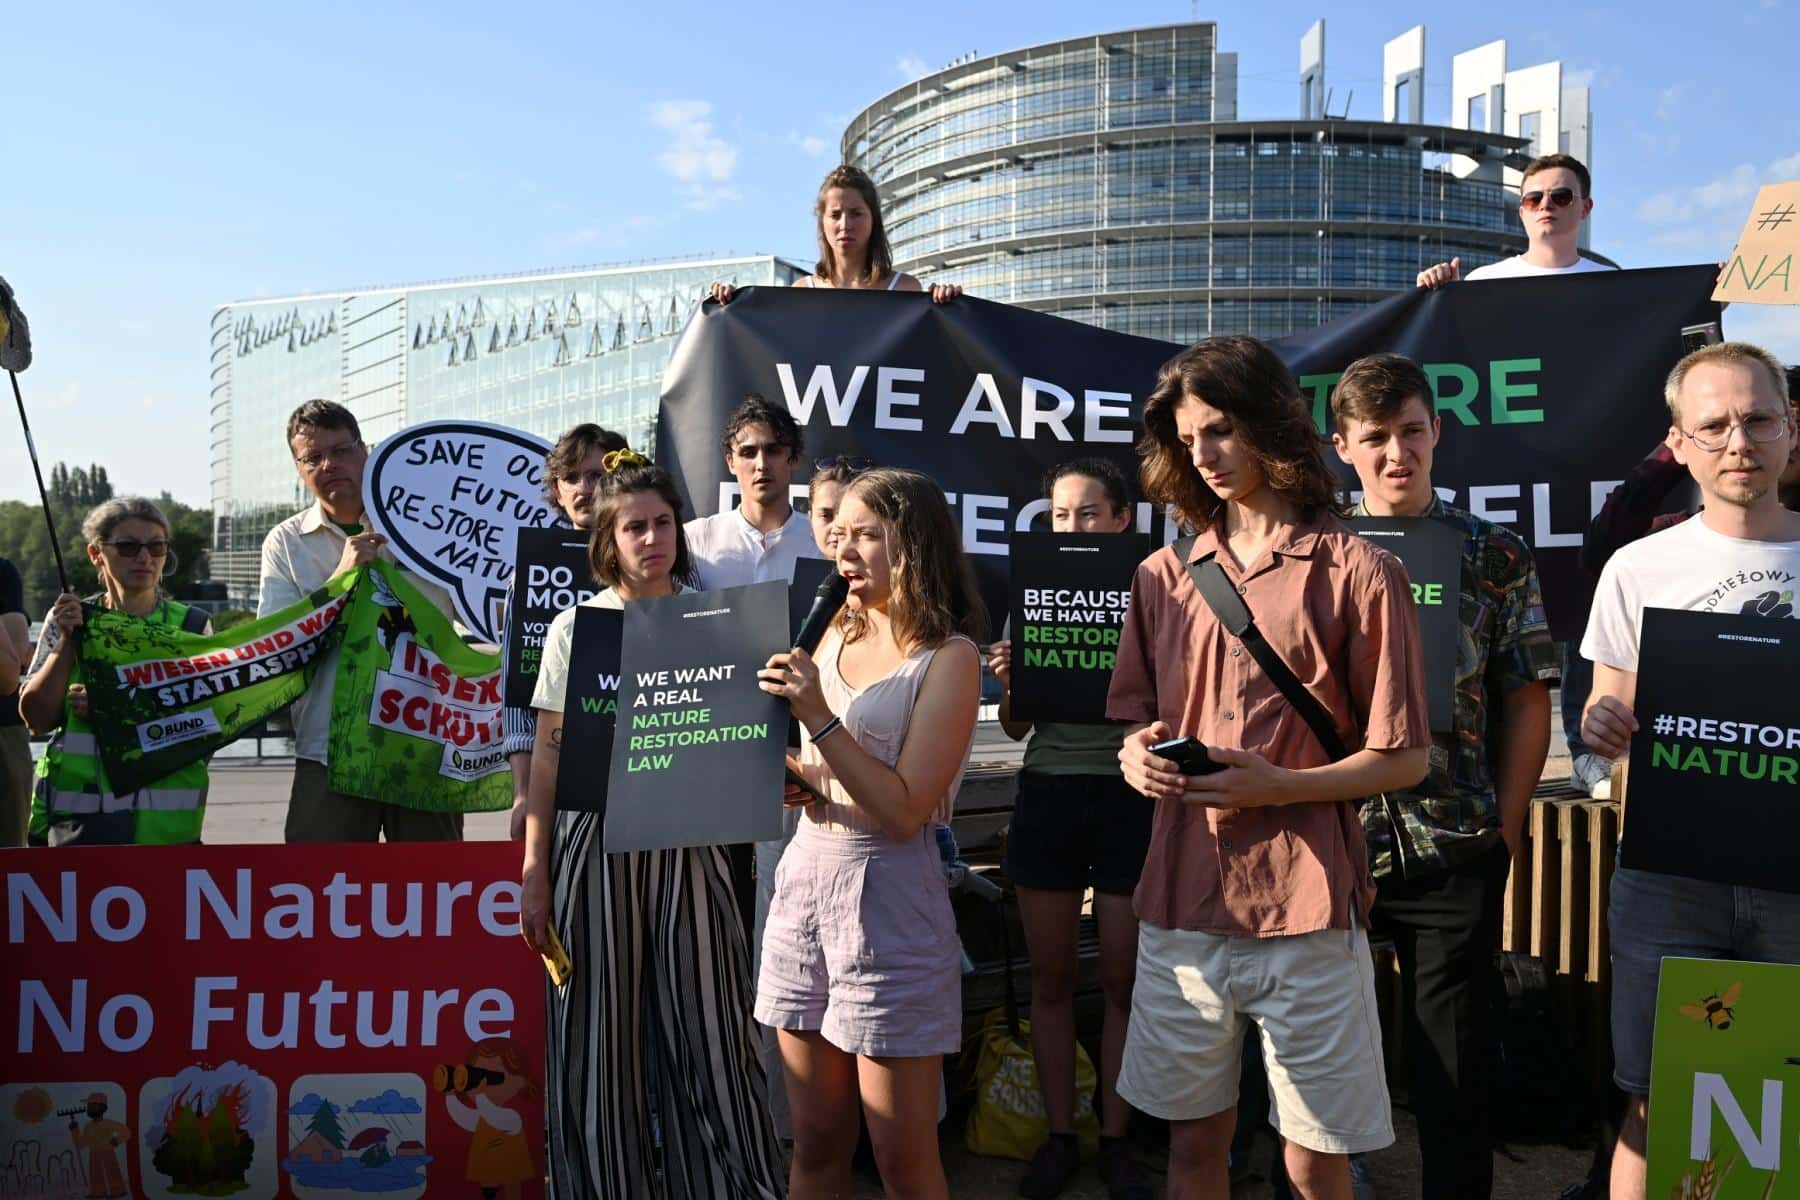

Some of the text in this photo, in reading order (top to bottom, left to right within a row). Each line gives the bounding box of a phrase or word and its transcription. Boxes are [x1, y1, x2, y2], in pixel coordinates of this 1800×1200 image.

[776, 363, 1133, 443] WE ARE
[405, 439, 545, 491] SAVE OU
[385, 485, 503, 555] RESTORE
[528, 565, 573, 588] DO
[1024, 589, 1131, 608] BECAUSE
[1024, 608, 1053, 622] WE
[1058, 610, 1106, 623] HAVE
[123, 653, 233, 685] WIESEN
[235, 630, 295, 661] UND
[156, 668, 240, 707] STATT
[637, 665, 735, 687] WE WANT
[633, 688, 703, 708] A REAL
[165, 718, 204, 735] BUND
[632, 709, 711, 729] NATURE
[630, 724, 768, 751] RESTORATION
[463, 752, 503, 770] BUND
[627, 754, 673, 772] LAW
[1652, 741, 1799, 785] NATUR
[6, 868, 522, 944] No Nature
[16, 976, 515, 1053] No Future
[1690, 1071, 1800, 1171] N
